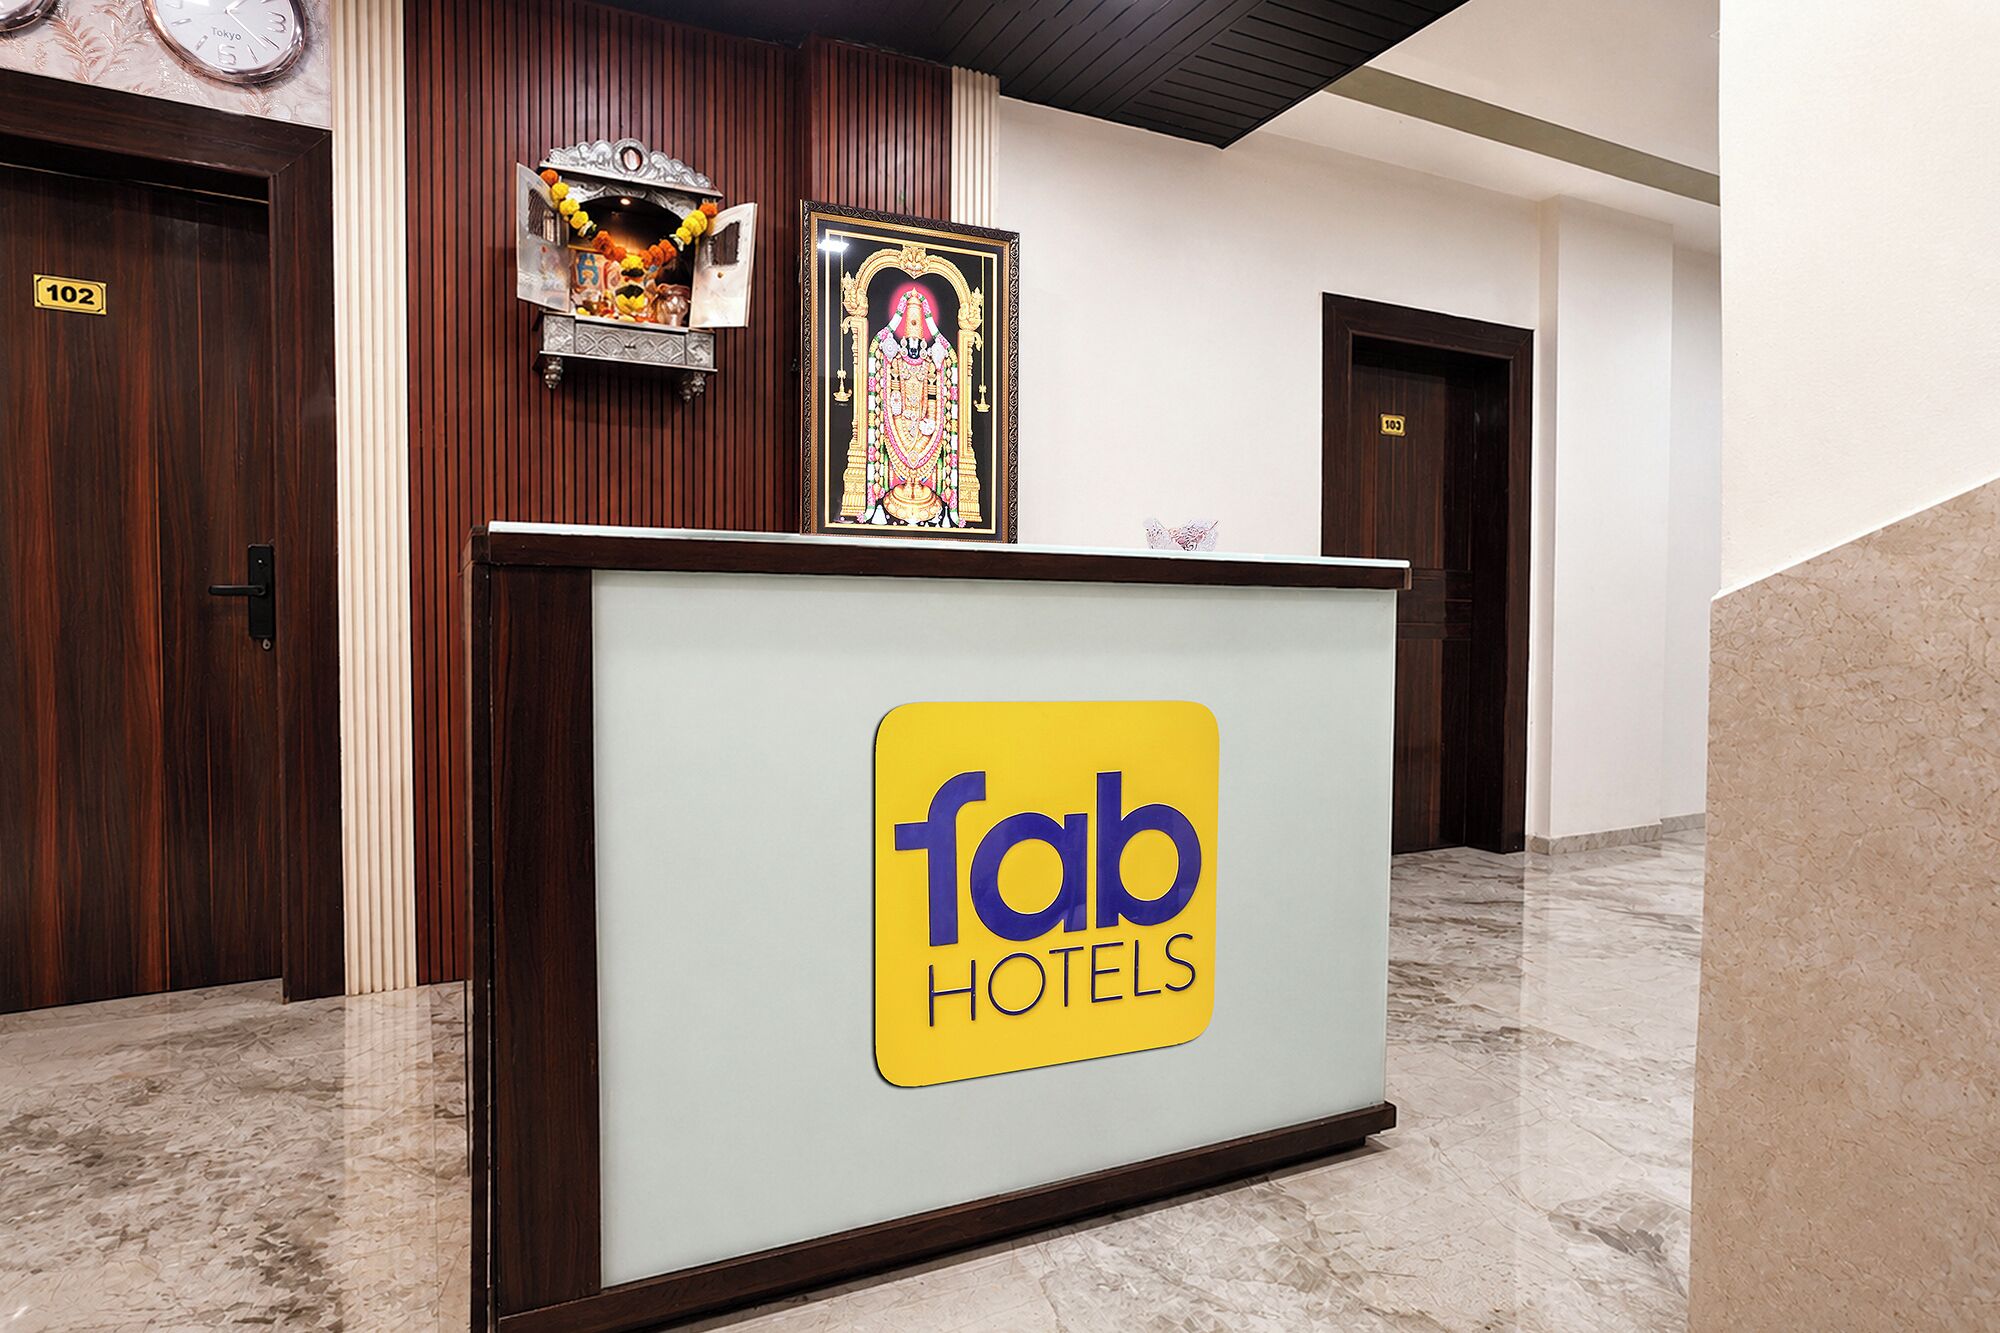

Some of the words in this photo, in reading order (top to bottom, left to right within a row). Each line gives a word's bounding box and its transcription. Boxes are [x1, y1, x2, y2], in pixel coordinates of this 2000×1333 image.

[265, 11, 286, 33] 3
[211, 26, 242, 41] Tokyo
[46, 284, 95, 305] 102
[1385, 419, 1402, 431] 103
[894, 770, 1202, 947] fab
[928, 932, 1197, 1027] HOTELS
